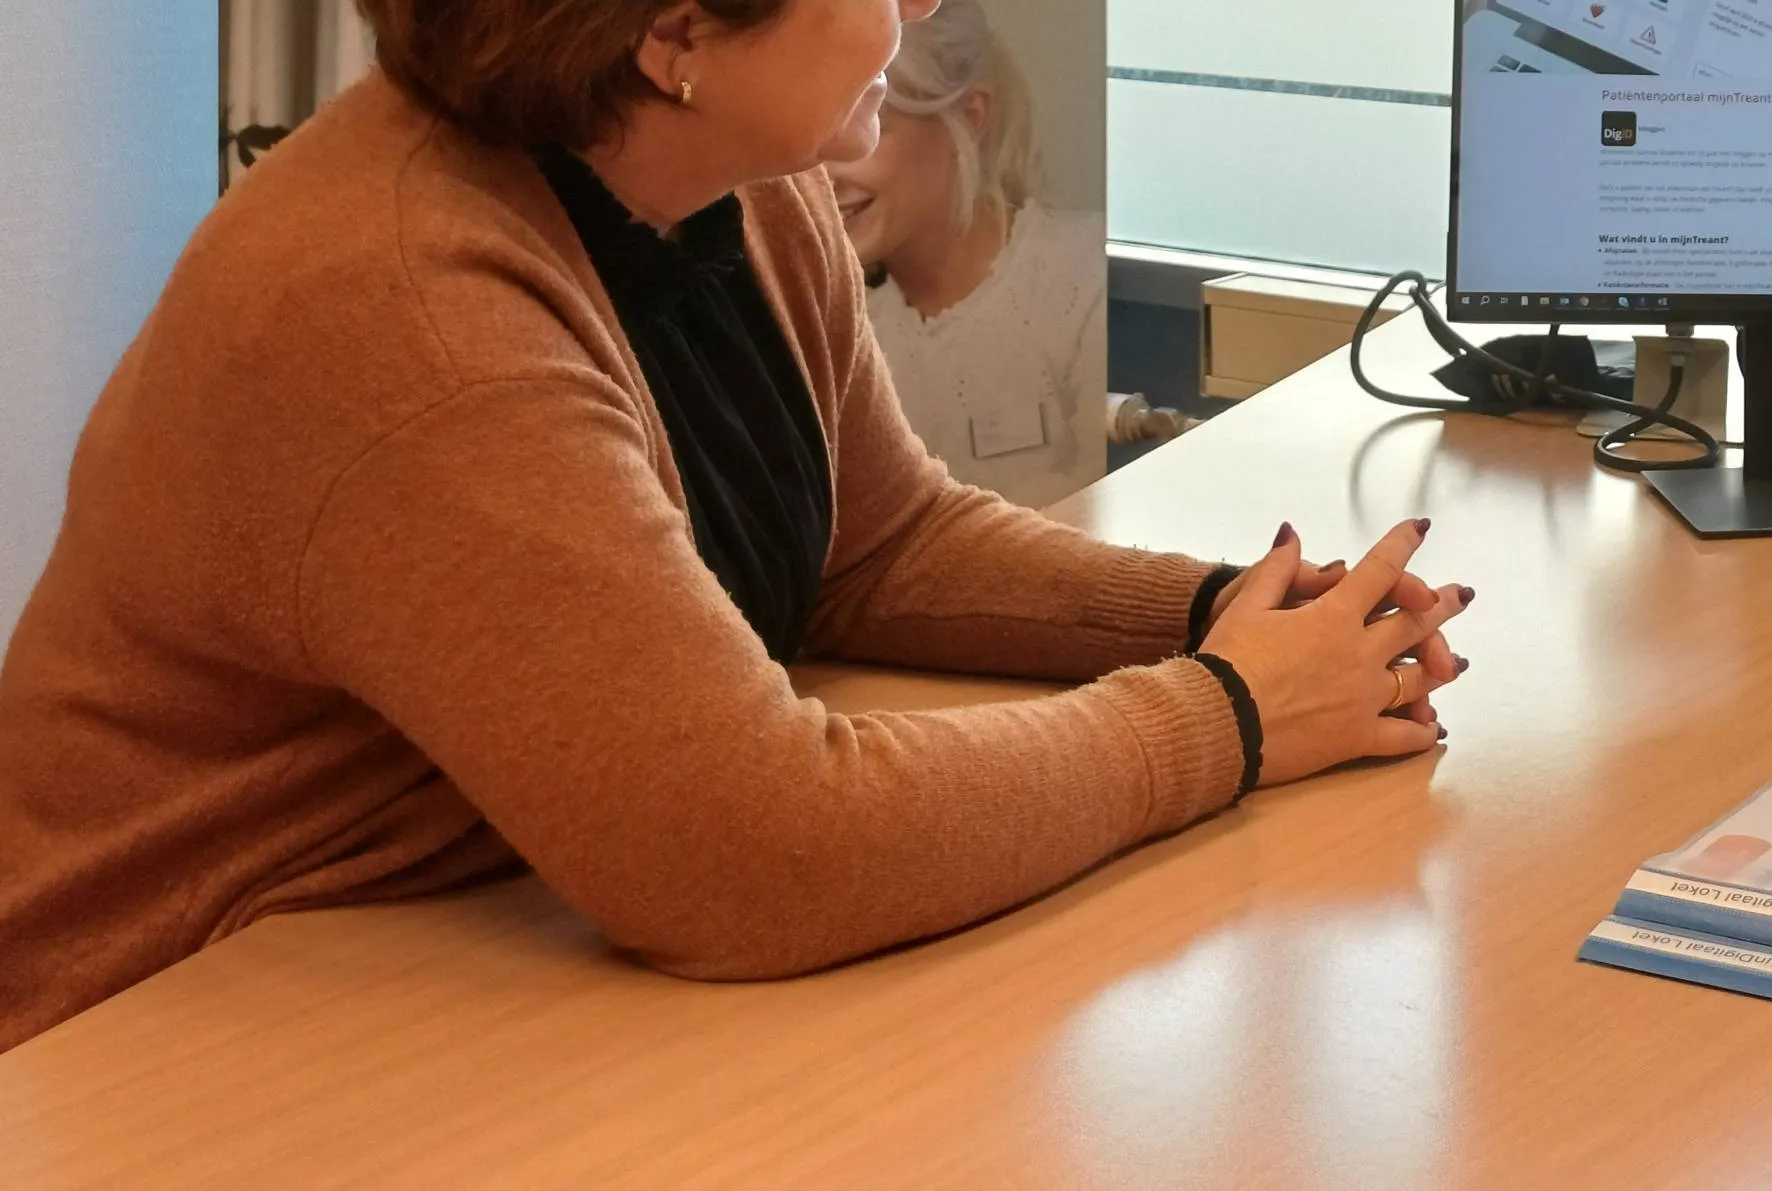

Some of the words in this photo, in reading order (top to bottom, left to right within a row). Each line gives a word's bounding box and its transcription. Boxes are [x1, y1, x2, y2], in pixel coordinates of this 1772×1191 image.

[1601, 89, 1704, 105] Patiëntenportaal
[1707, 91, 1772, 107] mijnTreant
[1603, 127, 1633, 142] DigiD
[1599, 234, 1619, 244] Wat
[1621, 234, 1648, 245] vindt
[1649, 236, 1657, 245] u
[1658, 234, 1669, 245] in
[1670, 234, 1730, 247] mijnTreant?
[1670, 881, 1723, 903] Loket
[1631, 930, 1683, 951] Loket
